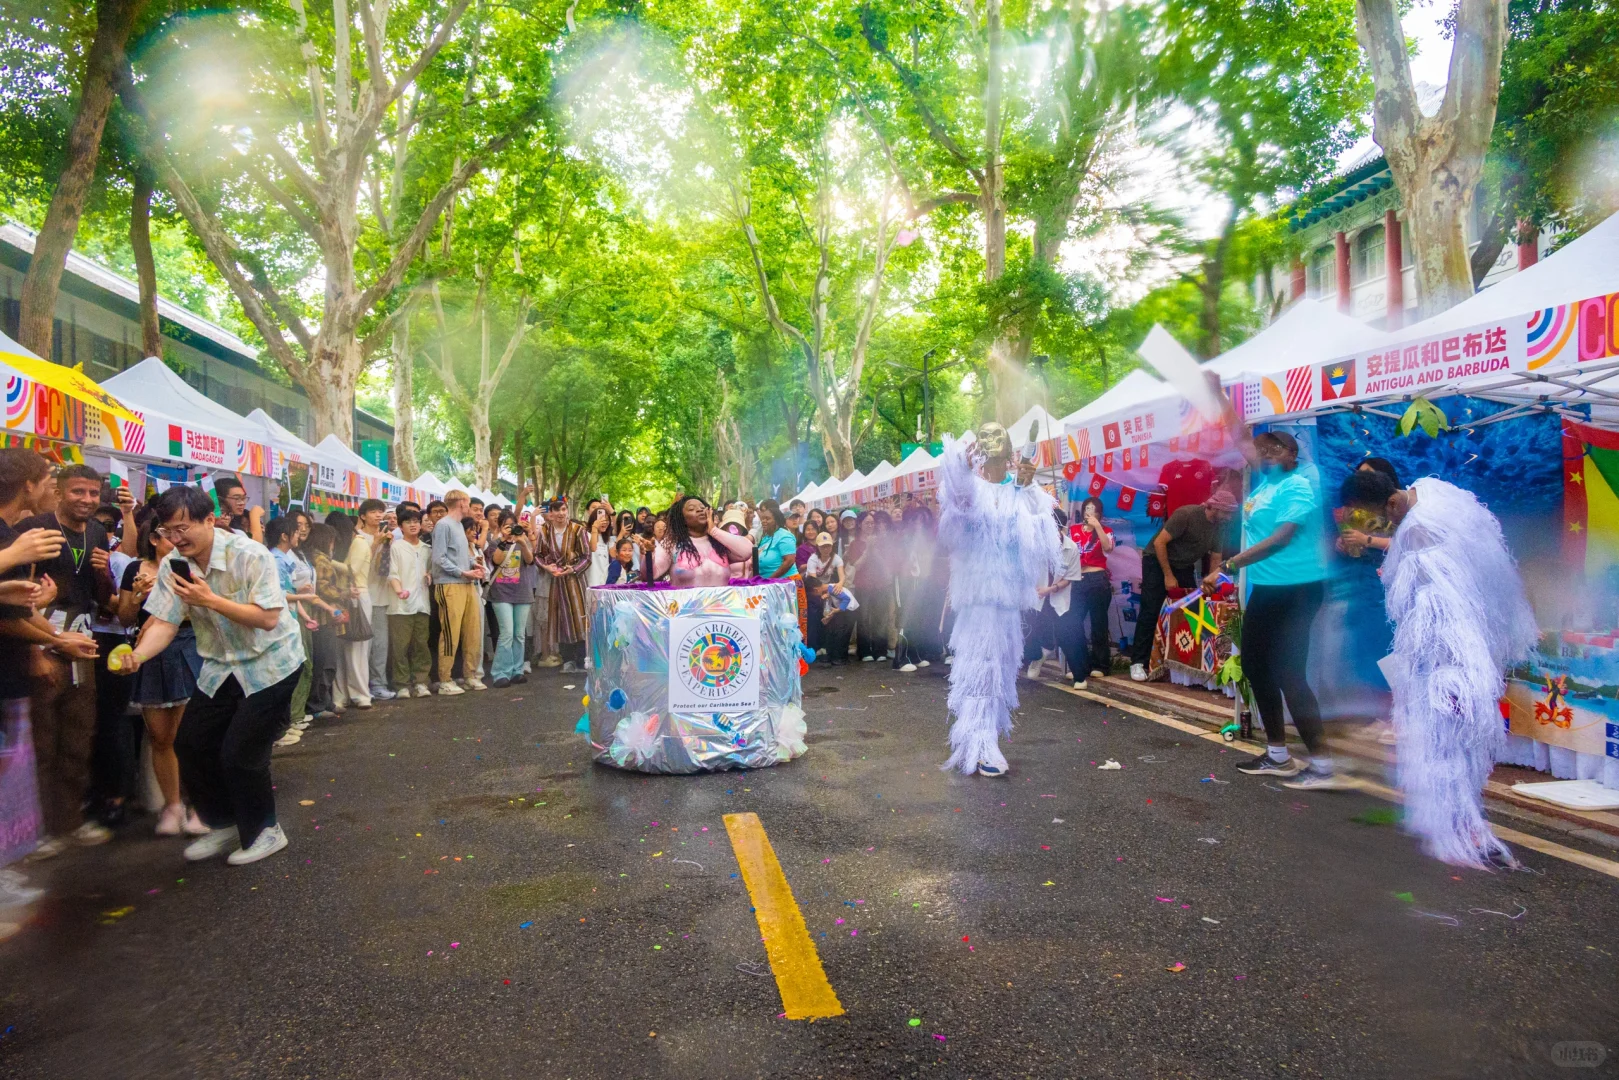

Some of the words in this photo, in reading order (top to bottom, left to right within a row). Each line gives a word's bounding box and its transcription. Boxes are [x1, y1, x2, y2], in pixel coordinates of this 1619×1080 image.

[1366, 326, 1507, 377] 安提瓜和巴布达
[1365, 374, 1414, 394] ANTIGUA
[1416, 368, 1444, 385] AND
[1447, 356, 1510, 379] BARBUDA
[1123, 413, 1155, 436] 突尼斯
[1131, 432, 1152, 443] TUNISIA
[186, 430, 225, 455] 马达加斯加
[191, 450, 224, 466] MADAGASCAR
[680, 635, 696, 661] THE
[695, 623, 751, 659] CARIBBEAN
[681, 670, 749, 698] EXPERIENCE
